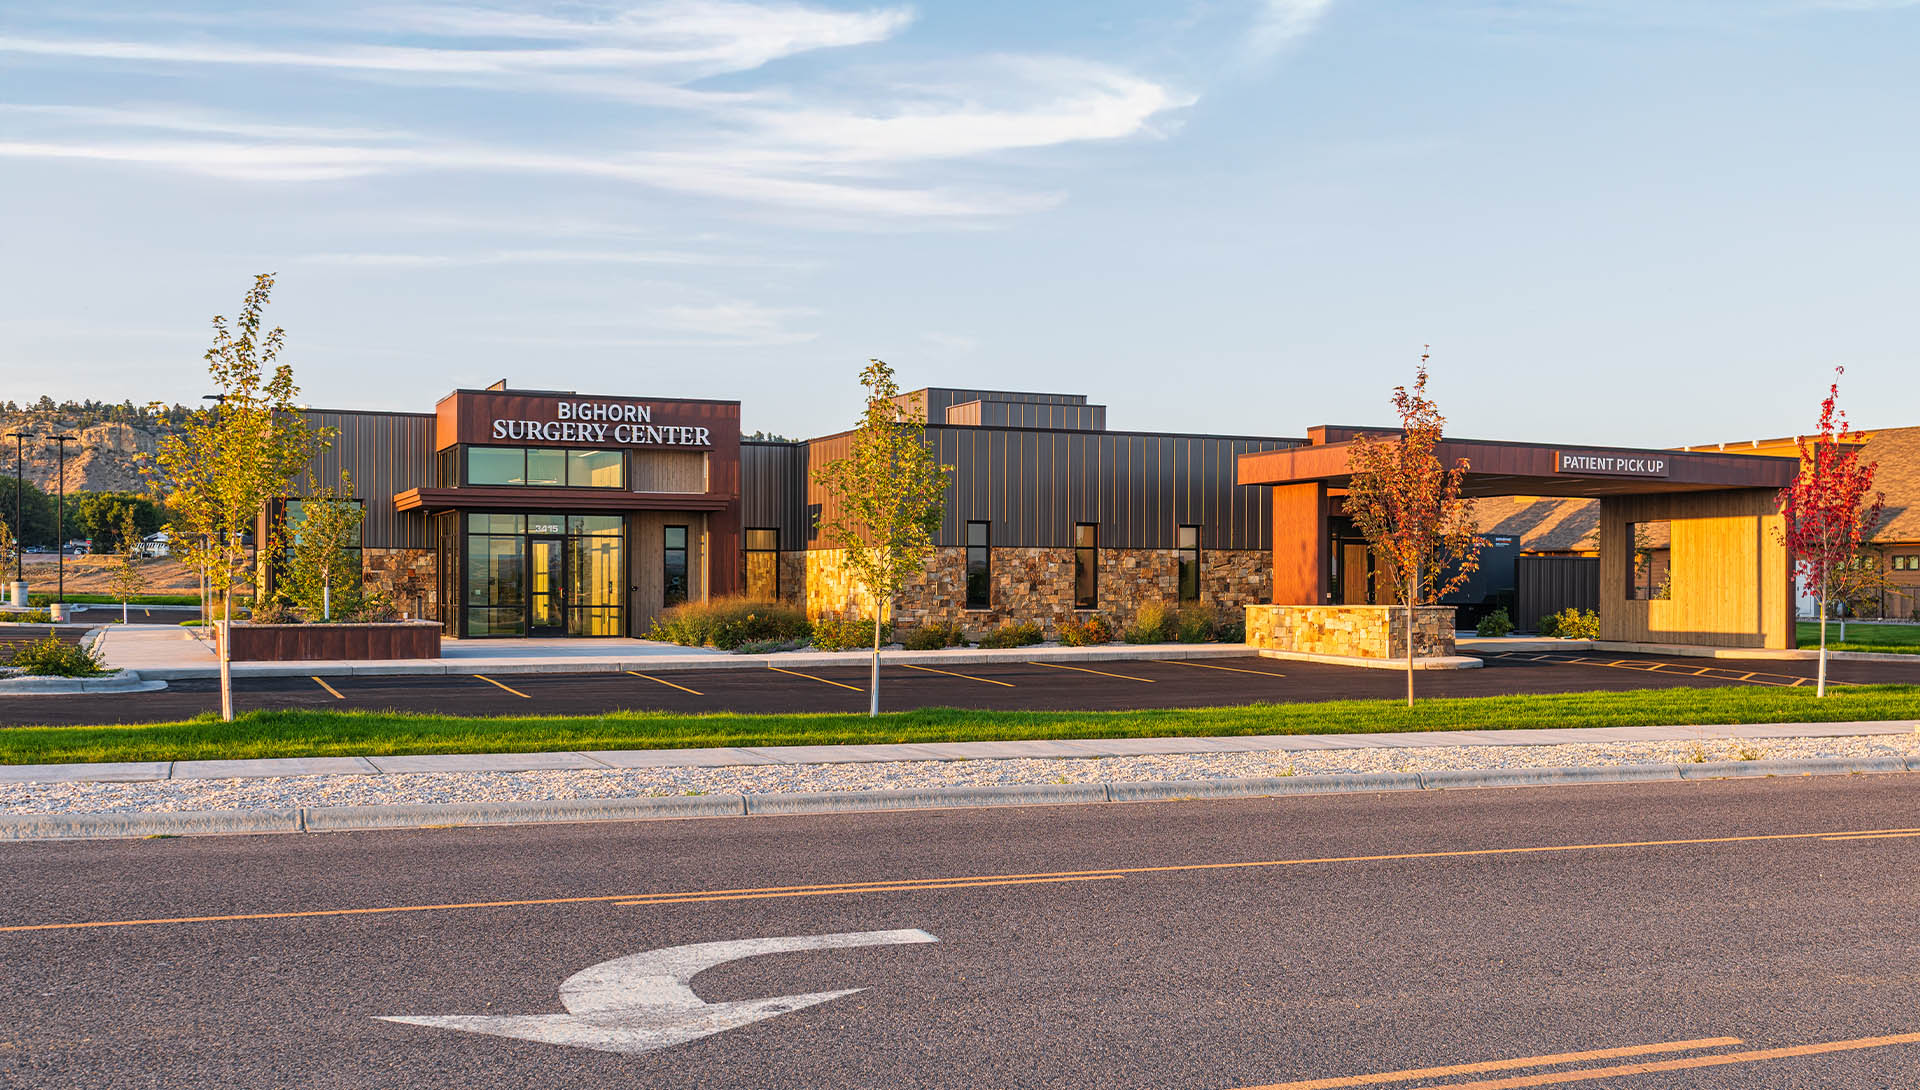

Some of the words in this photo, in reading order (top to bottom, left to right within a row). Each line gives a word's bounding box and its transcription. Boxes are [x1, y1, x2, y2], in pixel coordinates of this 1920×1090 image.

[558, 402, 651, 423] BIGHORN
[492, 419, 609, 442] SURGERY
[614, 424, 711, 446] CENTER
[1563, 455, 1614, 471] PATIENT
[1616, 458, 1645, 472] PICK
[1647, 460, 1664, 473] UP
[535, 524, 559, 533] 3415
